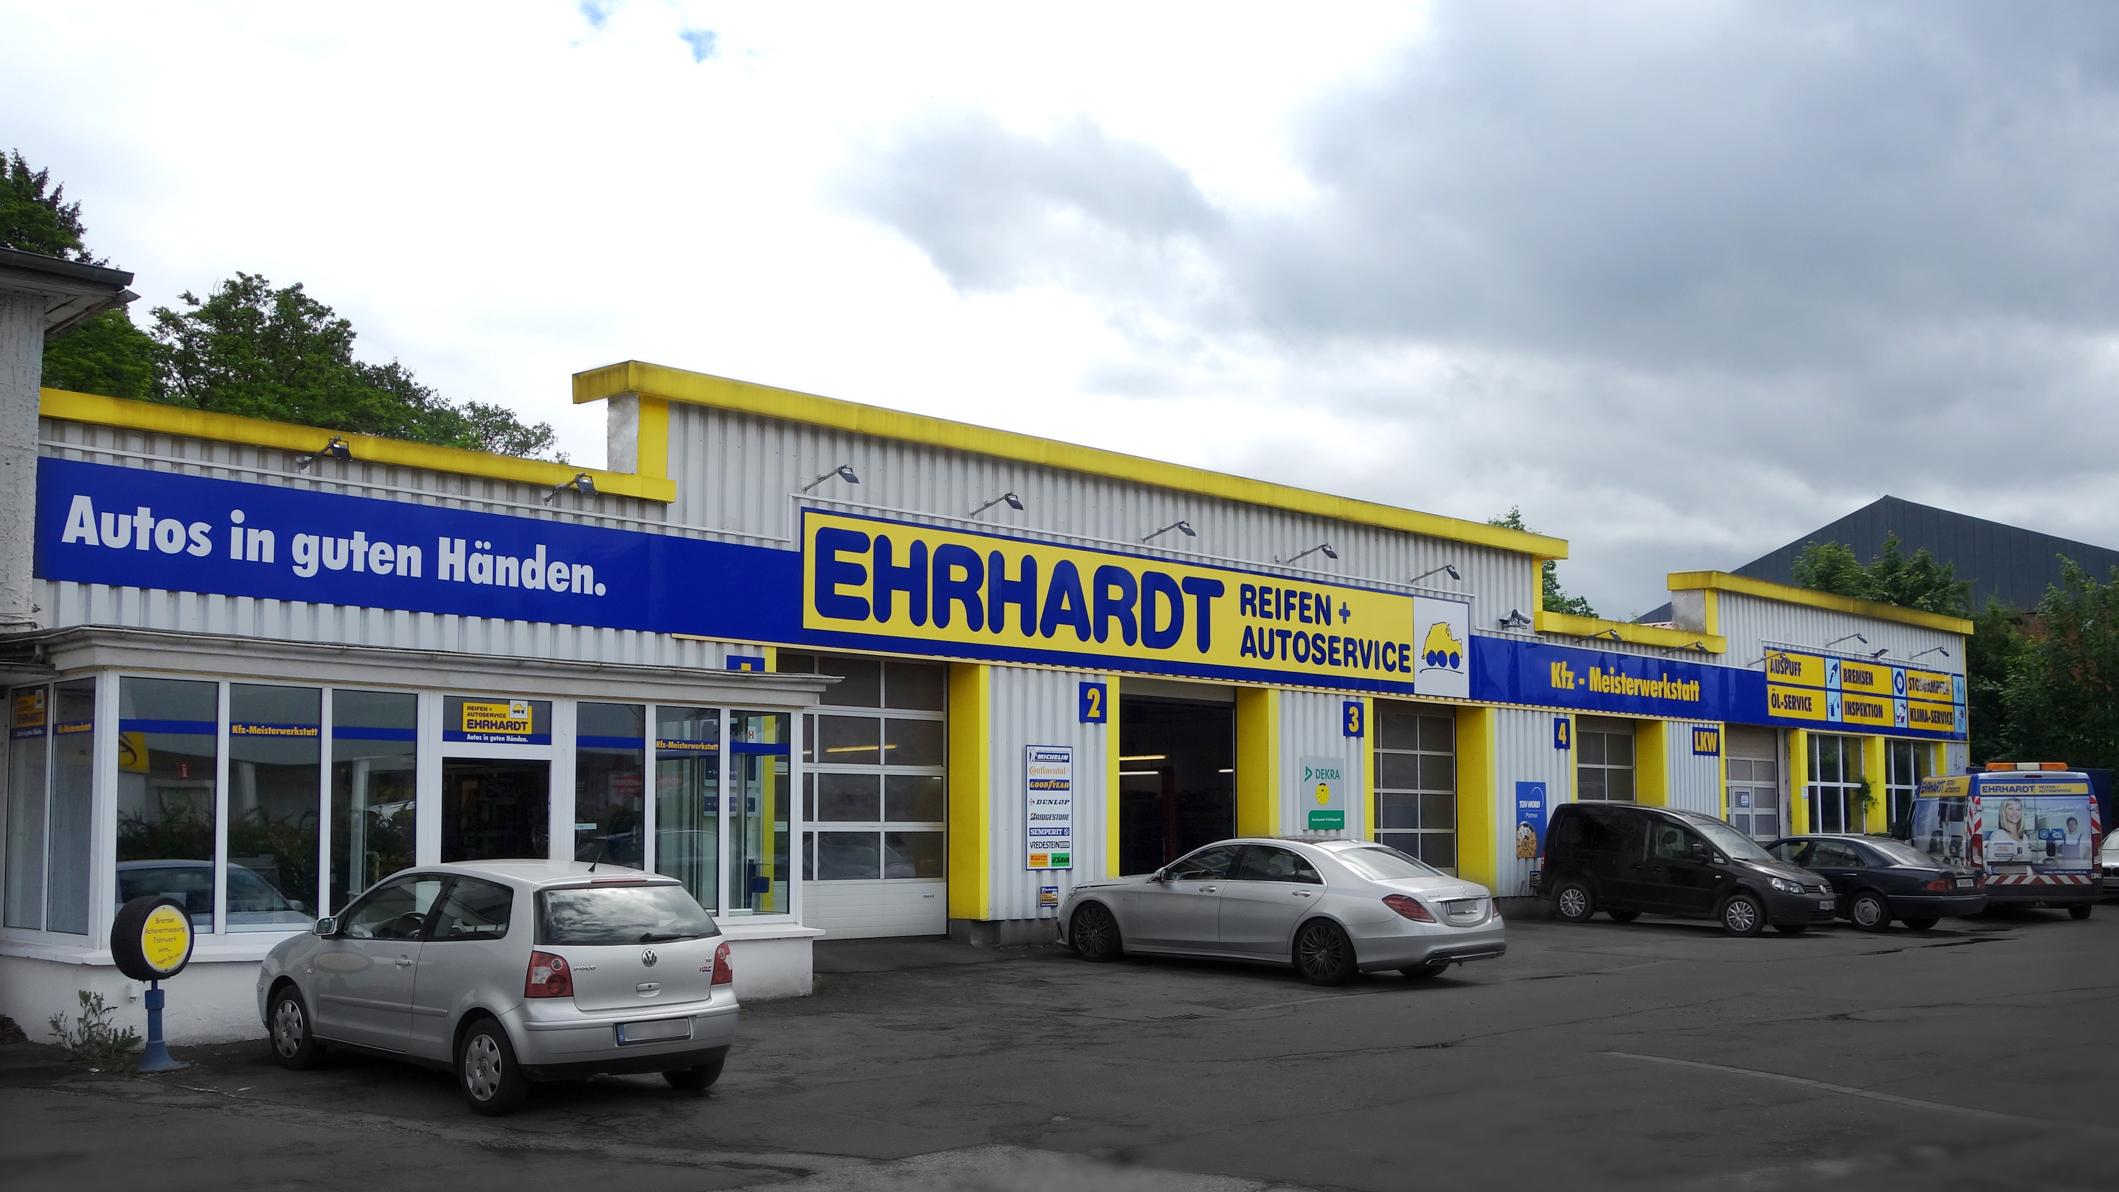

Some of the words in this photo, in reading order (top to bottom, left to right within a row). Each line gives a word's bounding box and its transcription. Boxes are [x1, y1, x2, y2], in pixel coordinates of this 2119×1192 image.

[61, 494, 212, 557] Autos
[230, 509, 275, 564] in
[291, 530, 422, 578] guten
[438, 536, 606, 597] Händen.
[814, 526, 1225, 654] EHRHARDT
[1240, 583, 1331, 626] REIFEN
[1338, 602, 1351, 625] +
[1240, 625, 1411, 673] AUTOSERVICE
[1770, 658, 1802, 677] AUSPUFF
[1843, 668, 1874, 686] BREMSEN
[1551, 661, 1575, 690] Kfz
[1589, 666, 1700, 702] Meisterwerkstatt
[1087, 688, 1100, 717] 2
[1771, 689, 1812, 712] ÖL-SERVICE
[1845, 701, 1883, 719] INSPEKTION
[467, 719, 528, 731] EHRHARDT
[1348, 706, 1359, 733] 3
[1910, 707, 1953, 726] KLIMA-SERVICE
[231, 724, 318, 737] Kfz-Meisterwerkstatt
[1558, 722, 1567, 745] 4
[656, 740, 719, 750] Kfz-Meisterwerkstatt
[1694, 731, 1717, 753] LKW
[1315, 769, 1340, 780] DEKRA
[1982, 785, 2036, 793] EHRHARDT
[1030, 812, 1070, 820] BRIDGESTONE
[1029, 841, 1060, 849] VREDESTEIN
